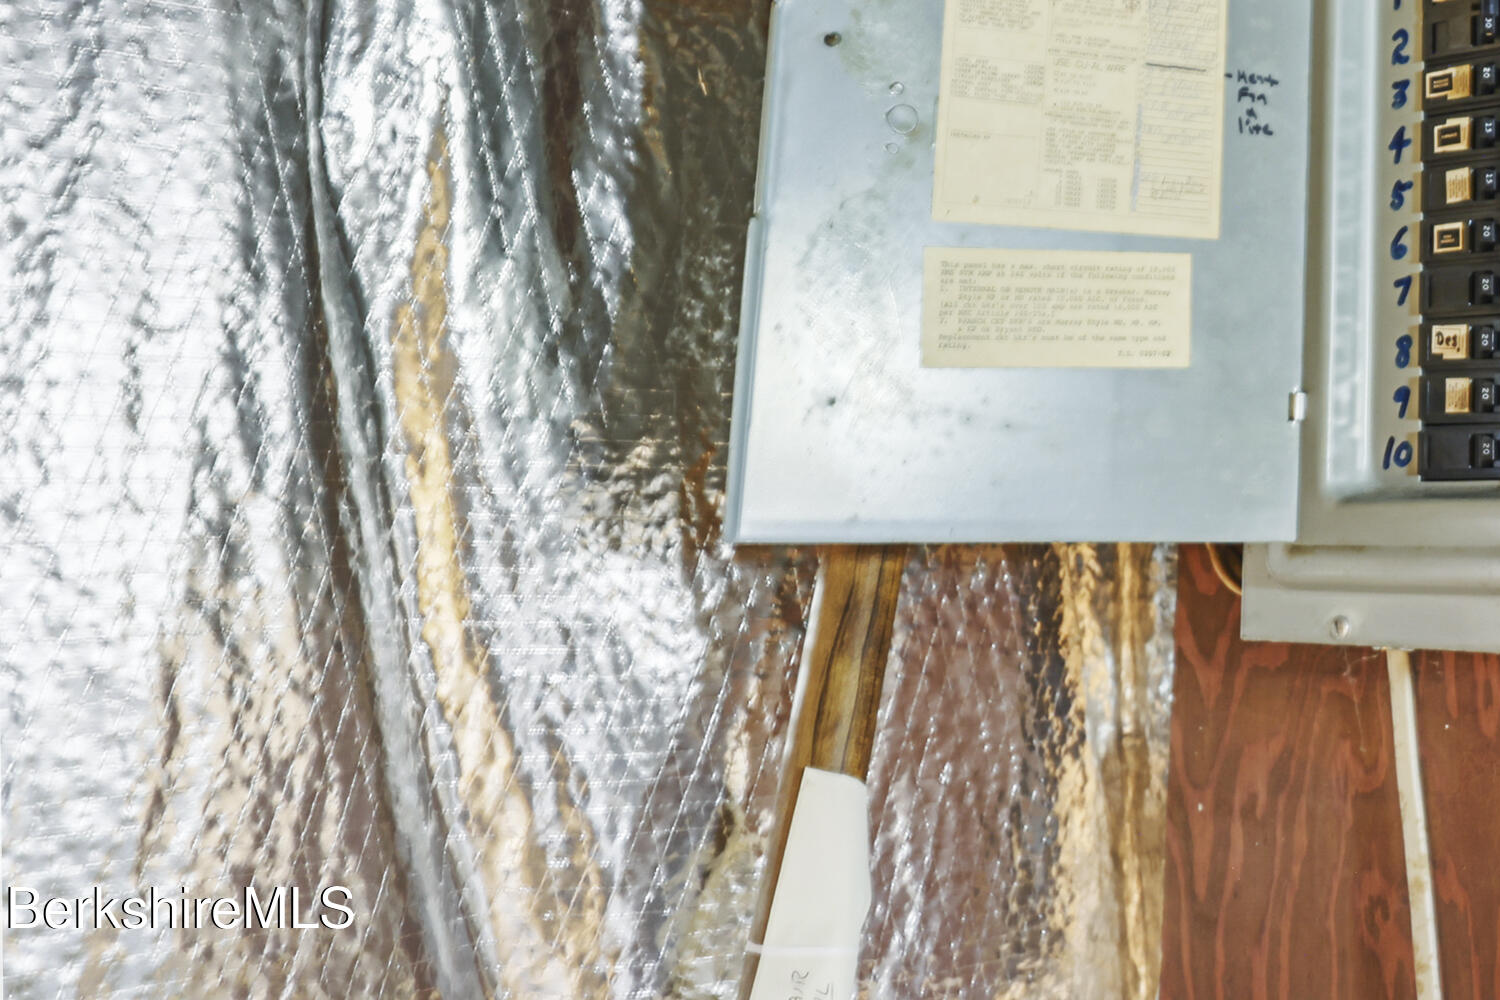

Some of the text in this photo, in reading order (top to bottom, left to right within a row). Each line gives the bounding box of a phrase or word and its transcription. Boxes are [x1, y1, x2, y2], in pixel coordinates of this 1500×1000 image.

[1484, 16, 1493, 30] 30
[1391, 28, 1410, 65] 2
[1482, 66, 1491, 80] 20
[1391, 79, 1411, 110] 3
[1388, 125, 1412, 165] 4
[1390, 179, 1413, 211] 5
[1390, 225, 1409, 261] 6
[1482, 224, 1491, 240] 20
[1392, 275, 1412, 307] 7
[1481, 277, 1490, 291] 20
[1395, 333, 1413, 369] 8
[1481, 333, 1489, 346] 20
[1392, 385, 1411, 419] 9
[1481, 387, 1490, 400] 20
[1383, 435, 1414, 470] 10
[1481, 442, 1490, 456] 20
